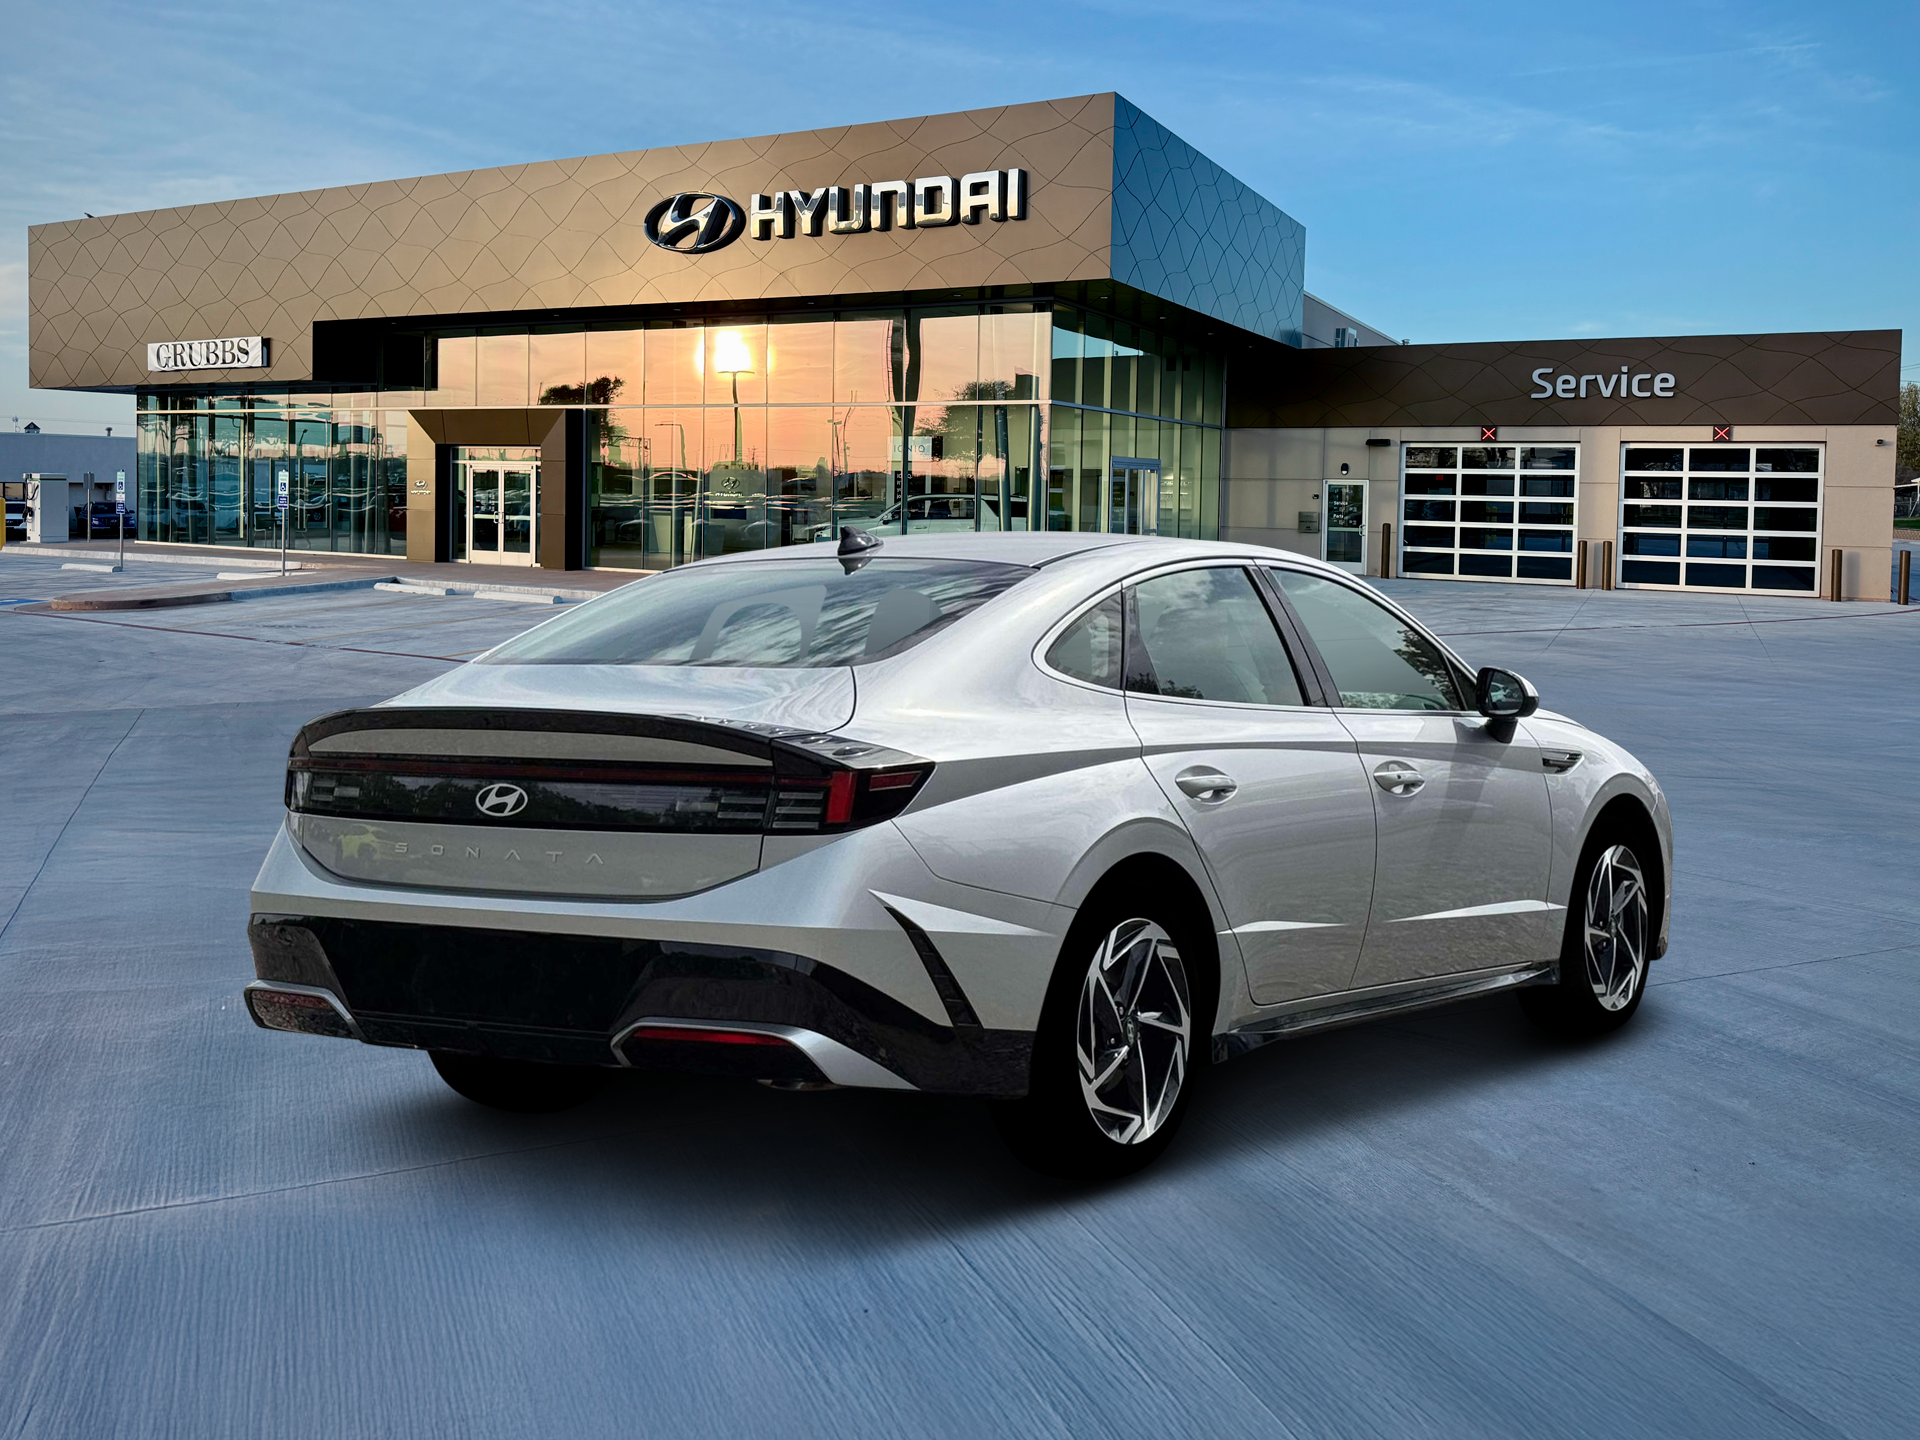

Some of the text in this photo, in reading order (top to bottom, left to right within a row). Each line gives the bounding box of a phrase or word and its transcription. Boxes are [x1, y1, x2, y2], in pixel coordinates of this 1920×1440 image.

[750, 168, 1026, 240] HYUNDAI
[156, 338, 250, 369] GRUBBS
[1530, 365, 1677, 399] Service
[394, 842, 604, 865] SONATA
